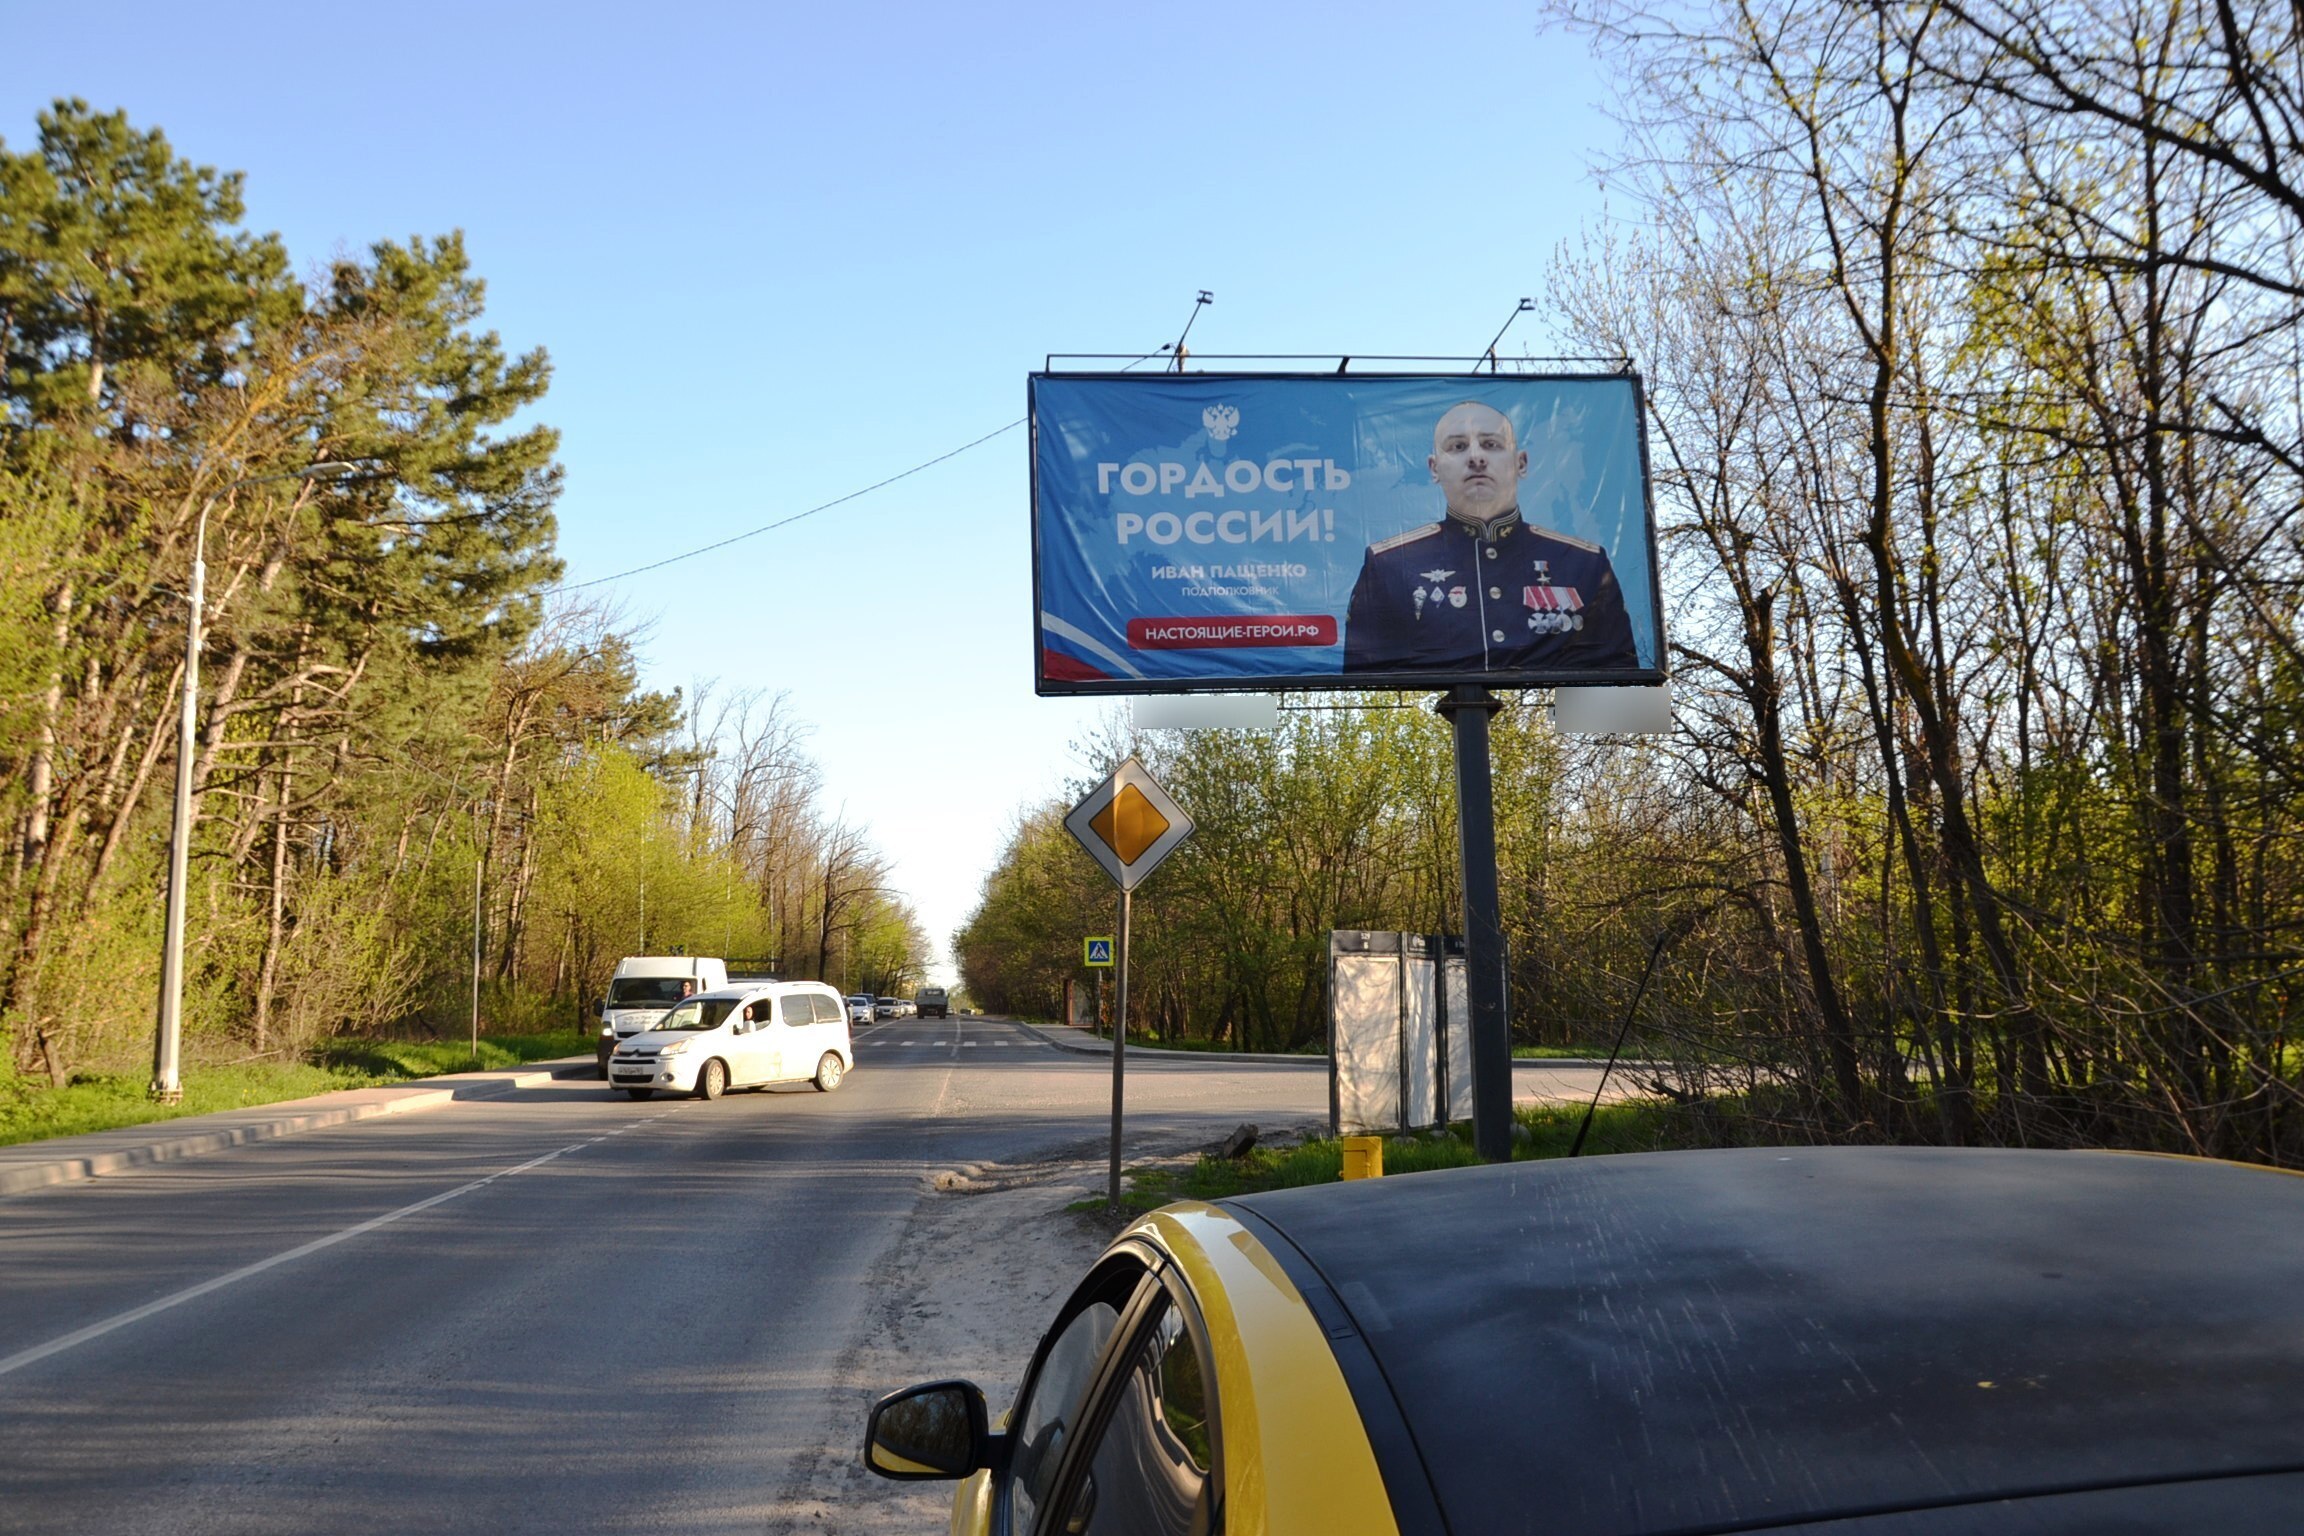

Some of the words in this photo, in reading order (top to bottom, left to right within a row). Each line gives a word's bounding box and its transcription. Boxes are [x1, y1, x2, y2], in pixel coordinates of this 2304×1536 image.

[1097, 459, 1351, 498] ГОРДОСТЬ
[1117, 509, 1336, 545] РОССИИ!
[1151, 566, 1204, 580] ИВАН
[1210, 563, 1307, 578] ПАЩЕНКО
[1181, 586, 1280, 597] ПОДПОЛКОВНИК
[1145, 624, 1320, 640] НАСТОЯЩИЕ-ГЕРОИ.РФ
